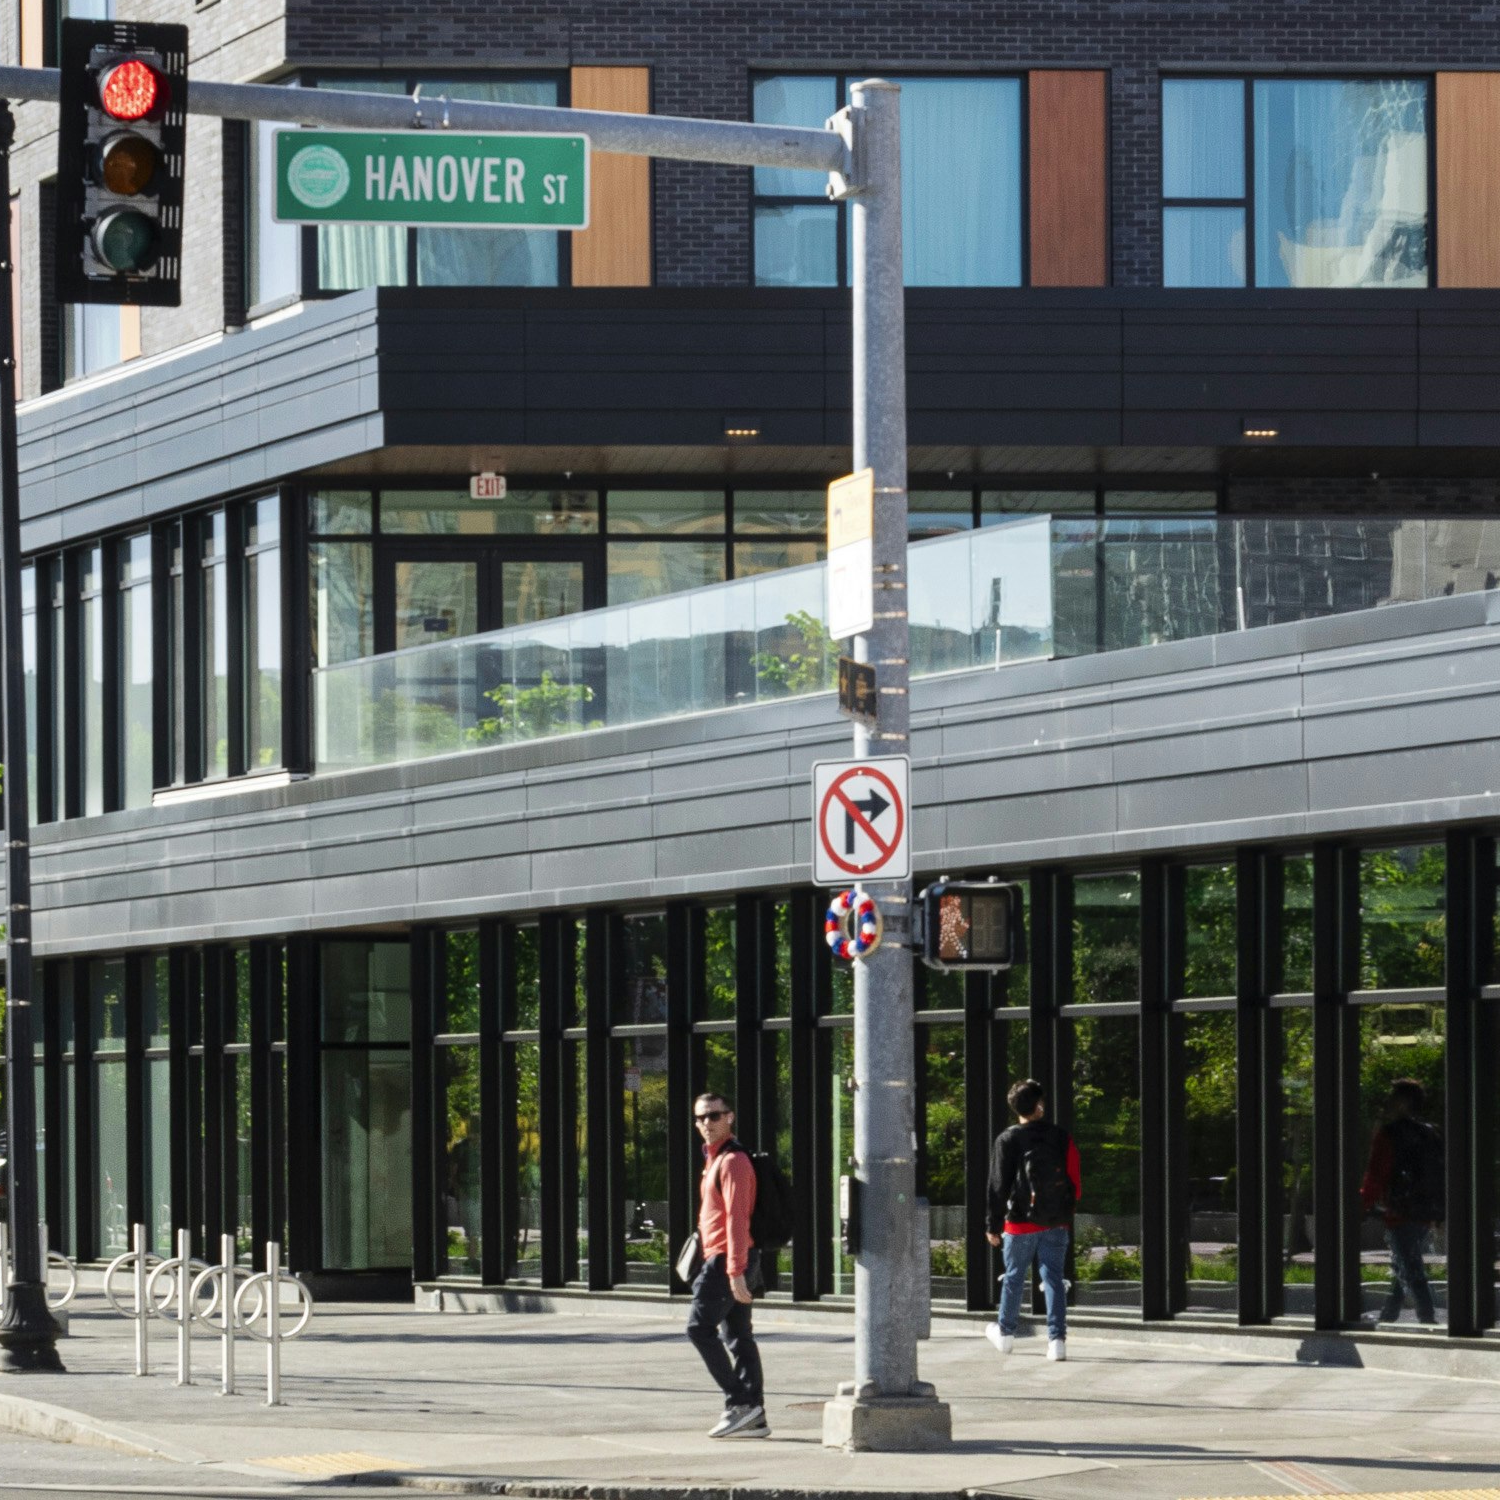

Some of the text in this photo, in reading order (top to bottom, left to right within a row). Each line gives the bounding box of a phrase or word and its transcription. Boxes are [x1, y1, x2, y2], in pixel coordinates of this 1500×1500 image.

[365, 154, 525, 203] HANOVER
[542, 173, 569, 205] ST
[476, 477, 501, 496] EXIT
